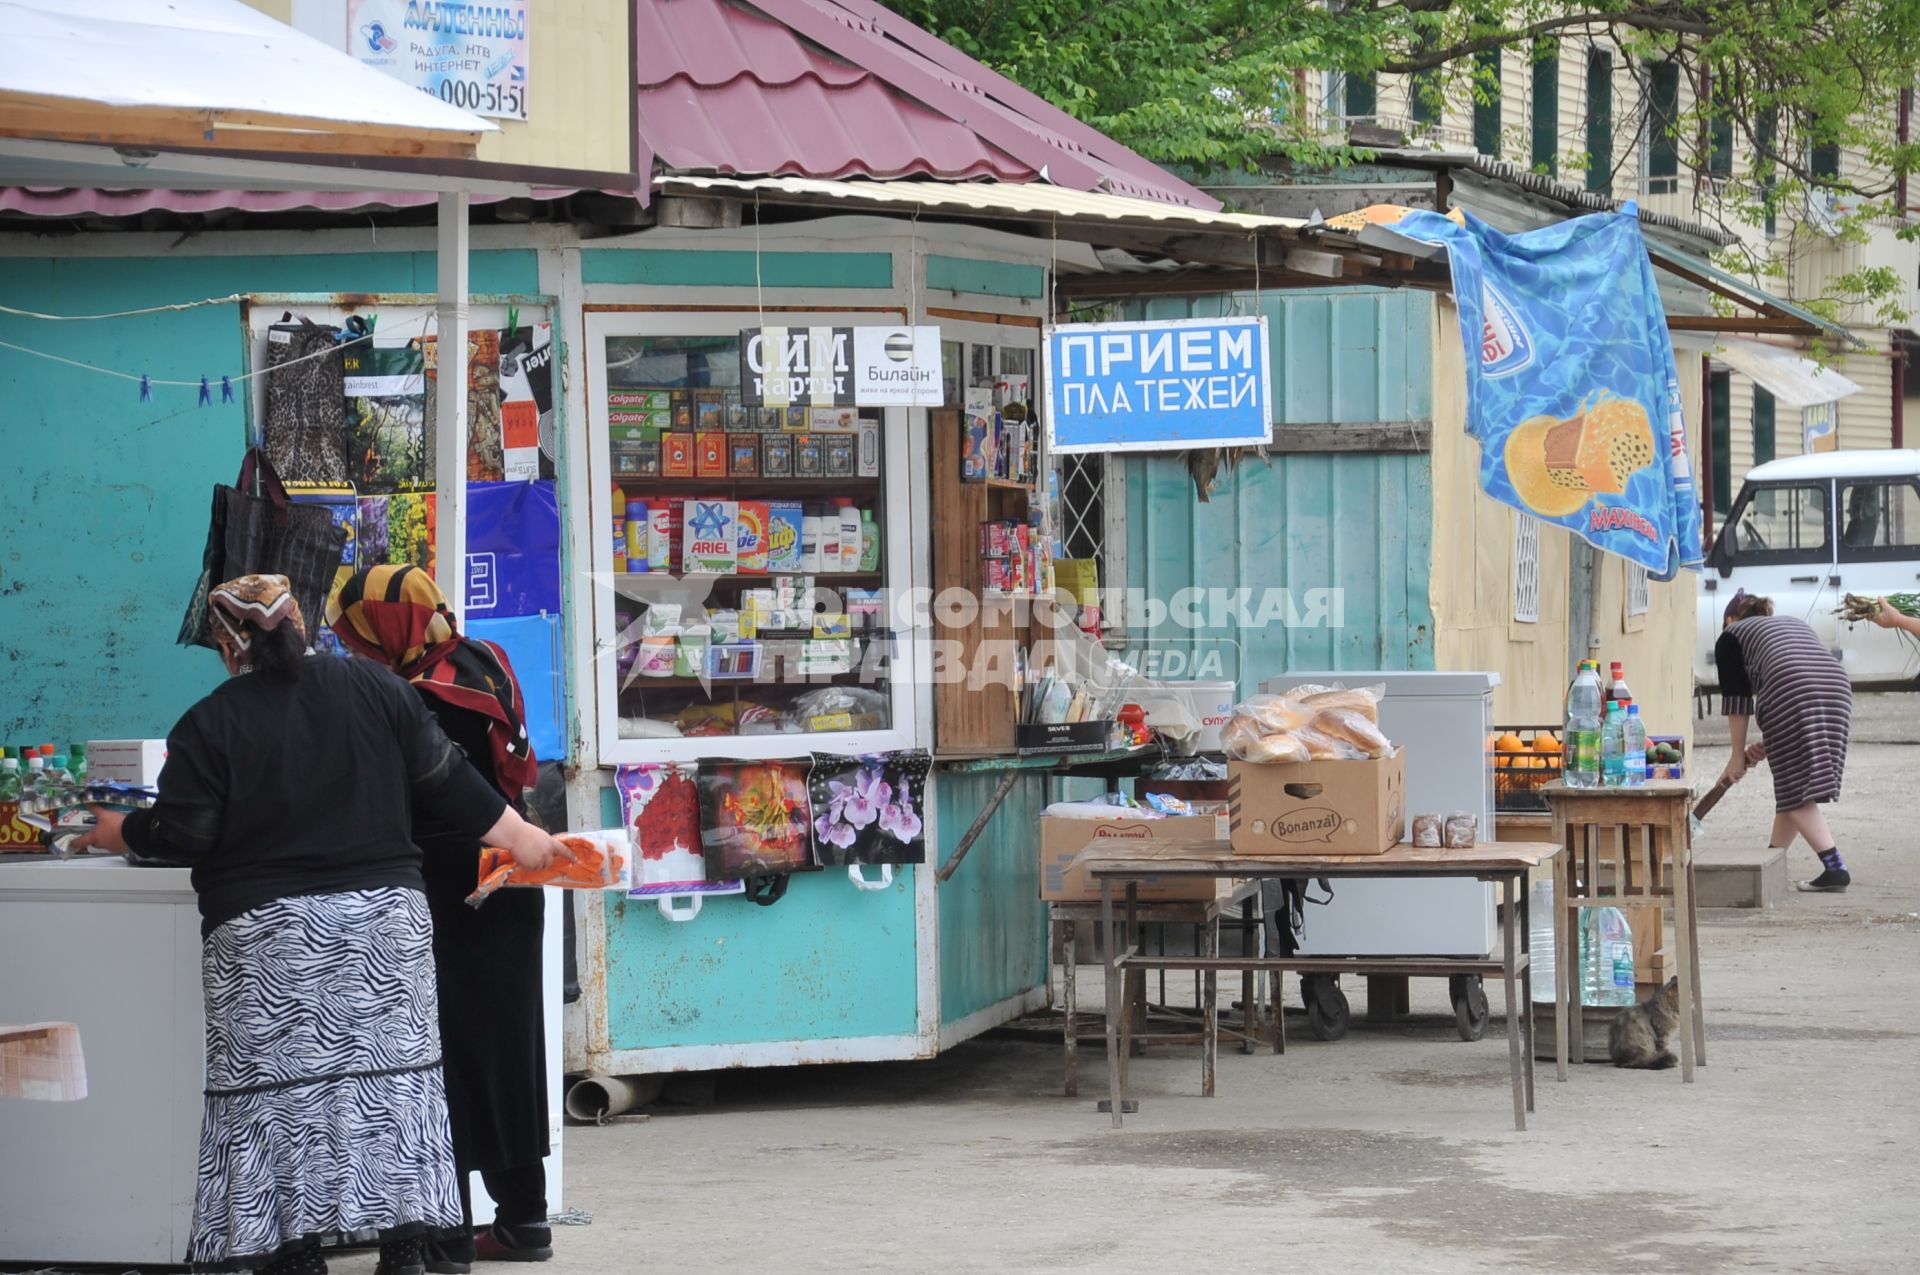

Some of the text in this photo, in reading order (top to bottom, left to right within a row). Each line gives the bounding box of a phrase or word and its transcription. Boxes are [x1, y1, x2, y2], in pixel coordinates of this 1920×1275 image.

[404, 0, 525, 40] АНТЕННЫ
[410, 42, 491, 58] РАДУГА, НТВ
[415, 60, 481, 72] ИНТЕРНЕТ
[747, 333, 849, 374] СИМ
[1060, 329, 1253, 377] ПРИЕМ
[608, 394, 644, 405] Colgate
[753, 376, 845, 402] карты
[691, 541, 731, 554] ARIEL
